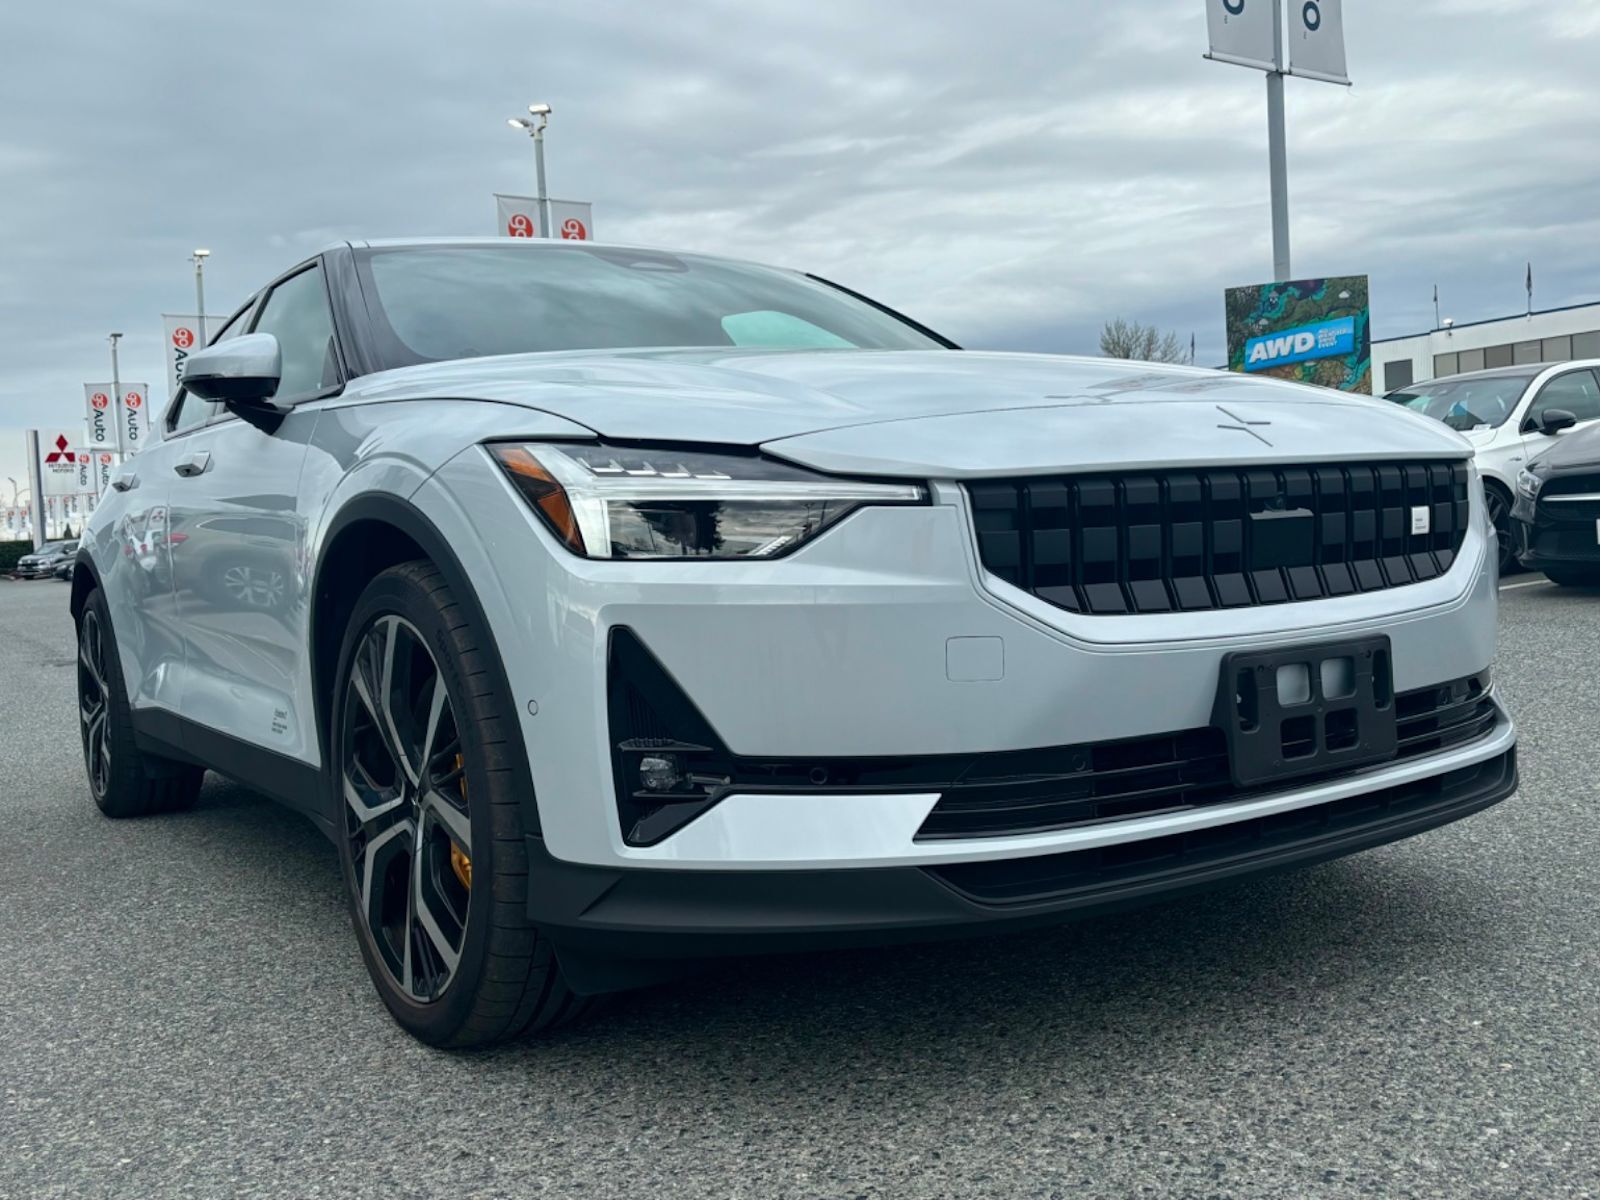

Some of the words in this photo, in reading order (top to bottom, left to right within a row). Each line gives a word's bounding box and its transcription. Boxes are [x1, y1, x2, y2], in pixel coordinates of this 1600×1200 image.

[1249, 331, 1315, 363] AWD
[93, 409, 106, 442] Auto
[127, 408, 139, 440] Auto
[80, 464, 88, 486] Auto
